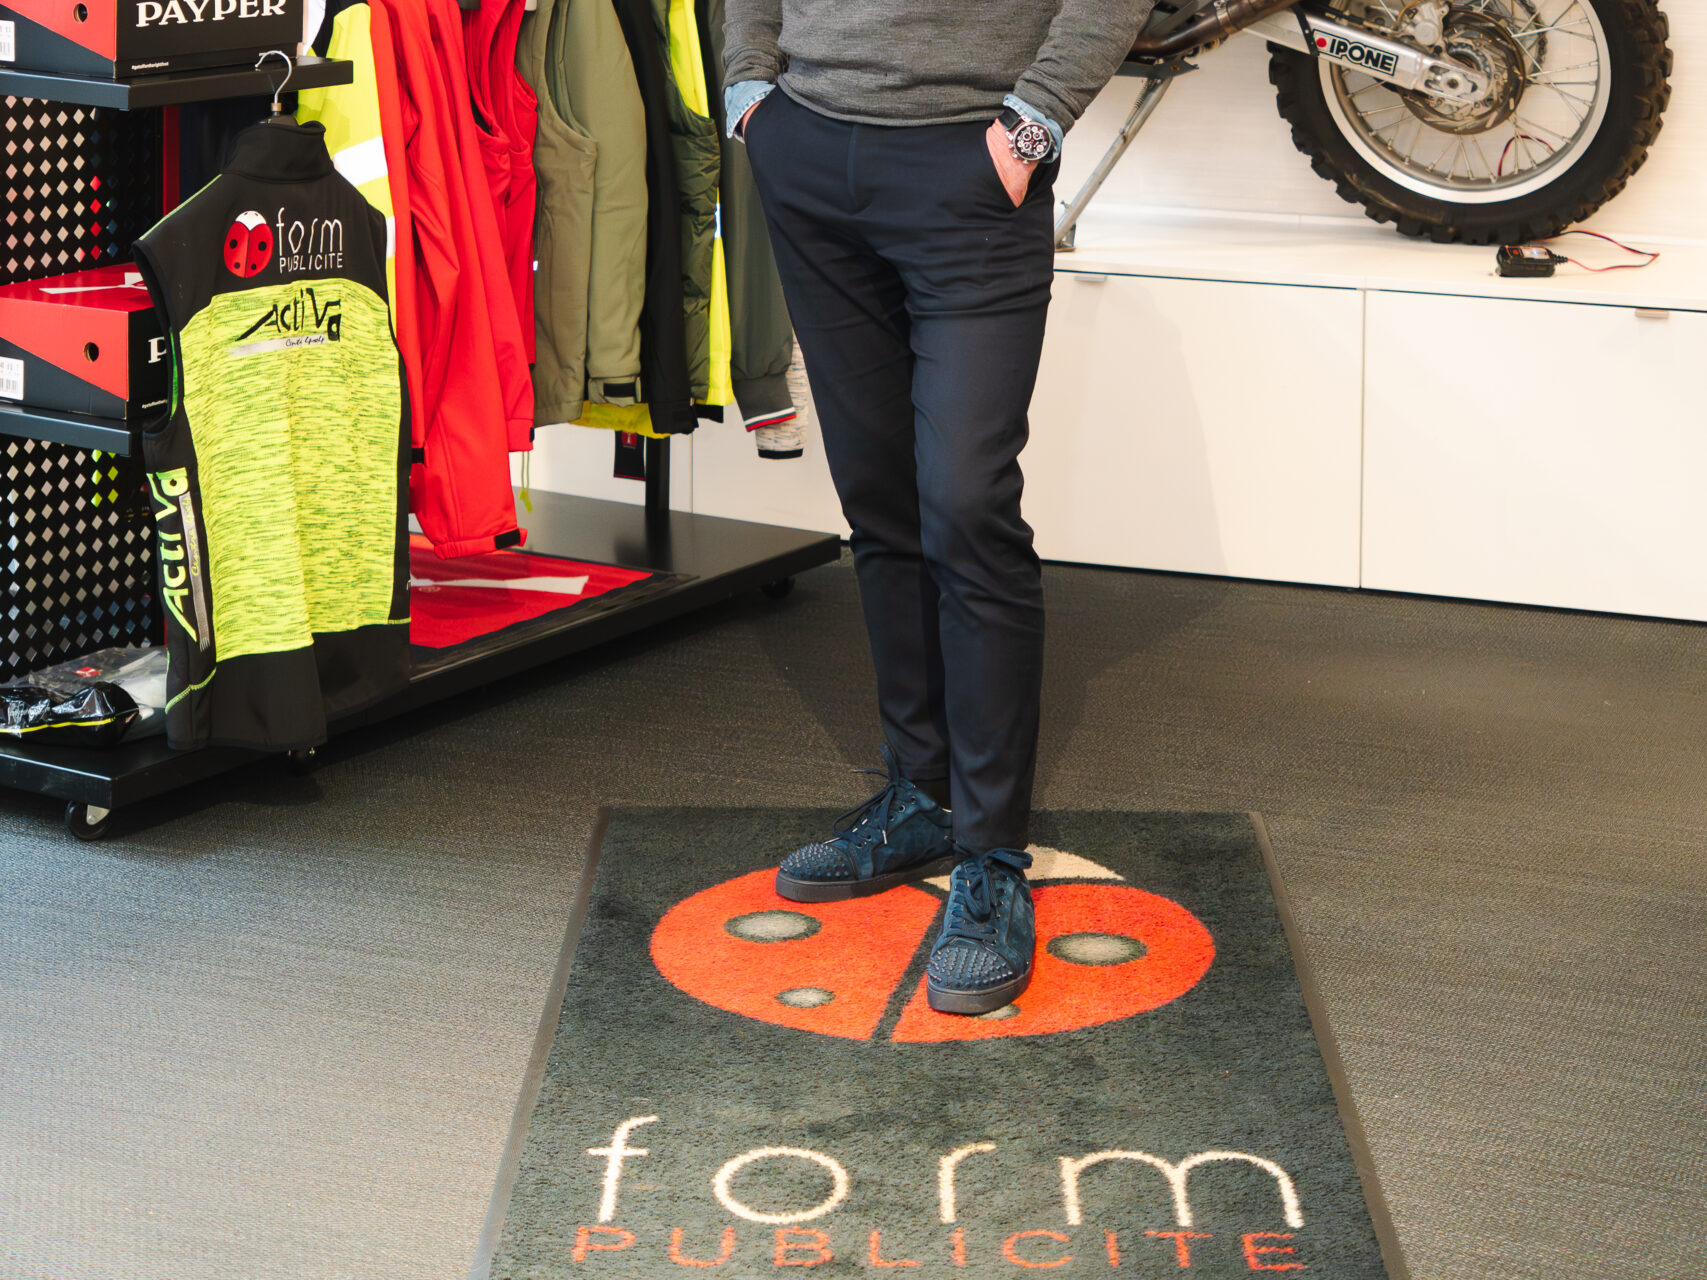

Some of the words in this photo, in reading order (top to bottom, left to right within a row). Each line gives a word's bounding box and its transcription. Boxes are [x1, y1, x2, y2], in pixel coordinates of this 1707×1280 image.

[1329, 38, 1398, 72] IPONE
[276, 207, 343, 257] form
[279, 252, 343, 274] PUBLICITE
[586, 1115, 1303, 1228] form
[571, 1226, 1306, 1270] PUBLICITE
